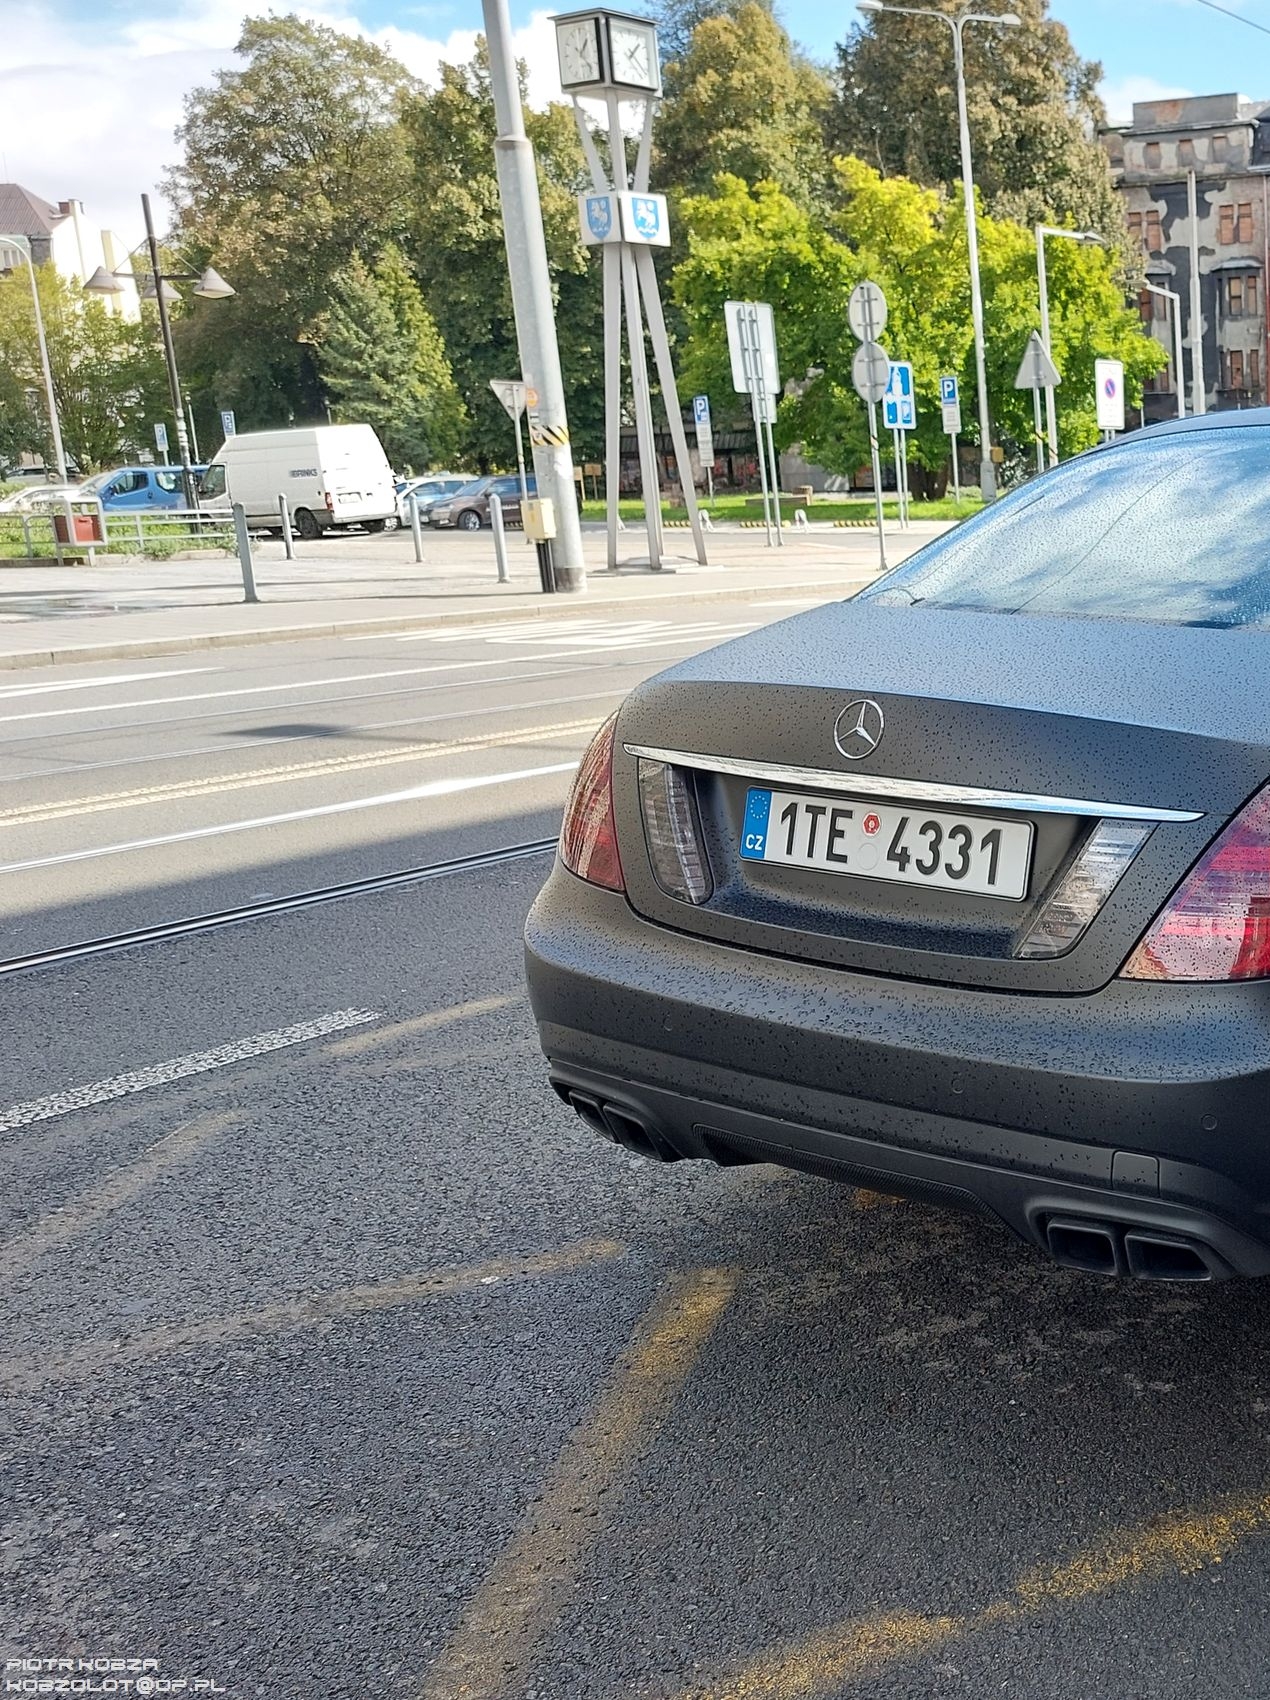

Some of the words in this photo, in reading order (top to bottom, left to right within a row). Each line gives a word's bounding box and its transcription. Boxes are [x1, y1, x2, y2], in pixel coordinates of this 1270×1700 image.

[745, 834, 763, 851] CZ
[780, 802, 854, 864] 1TE
[886, 815, 1004, 886] 4331
